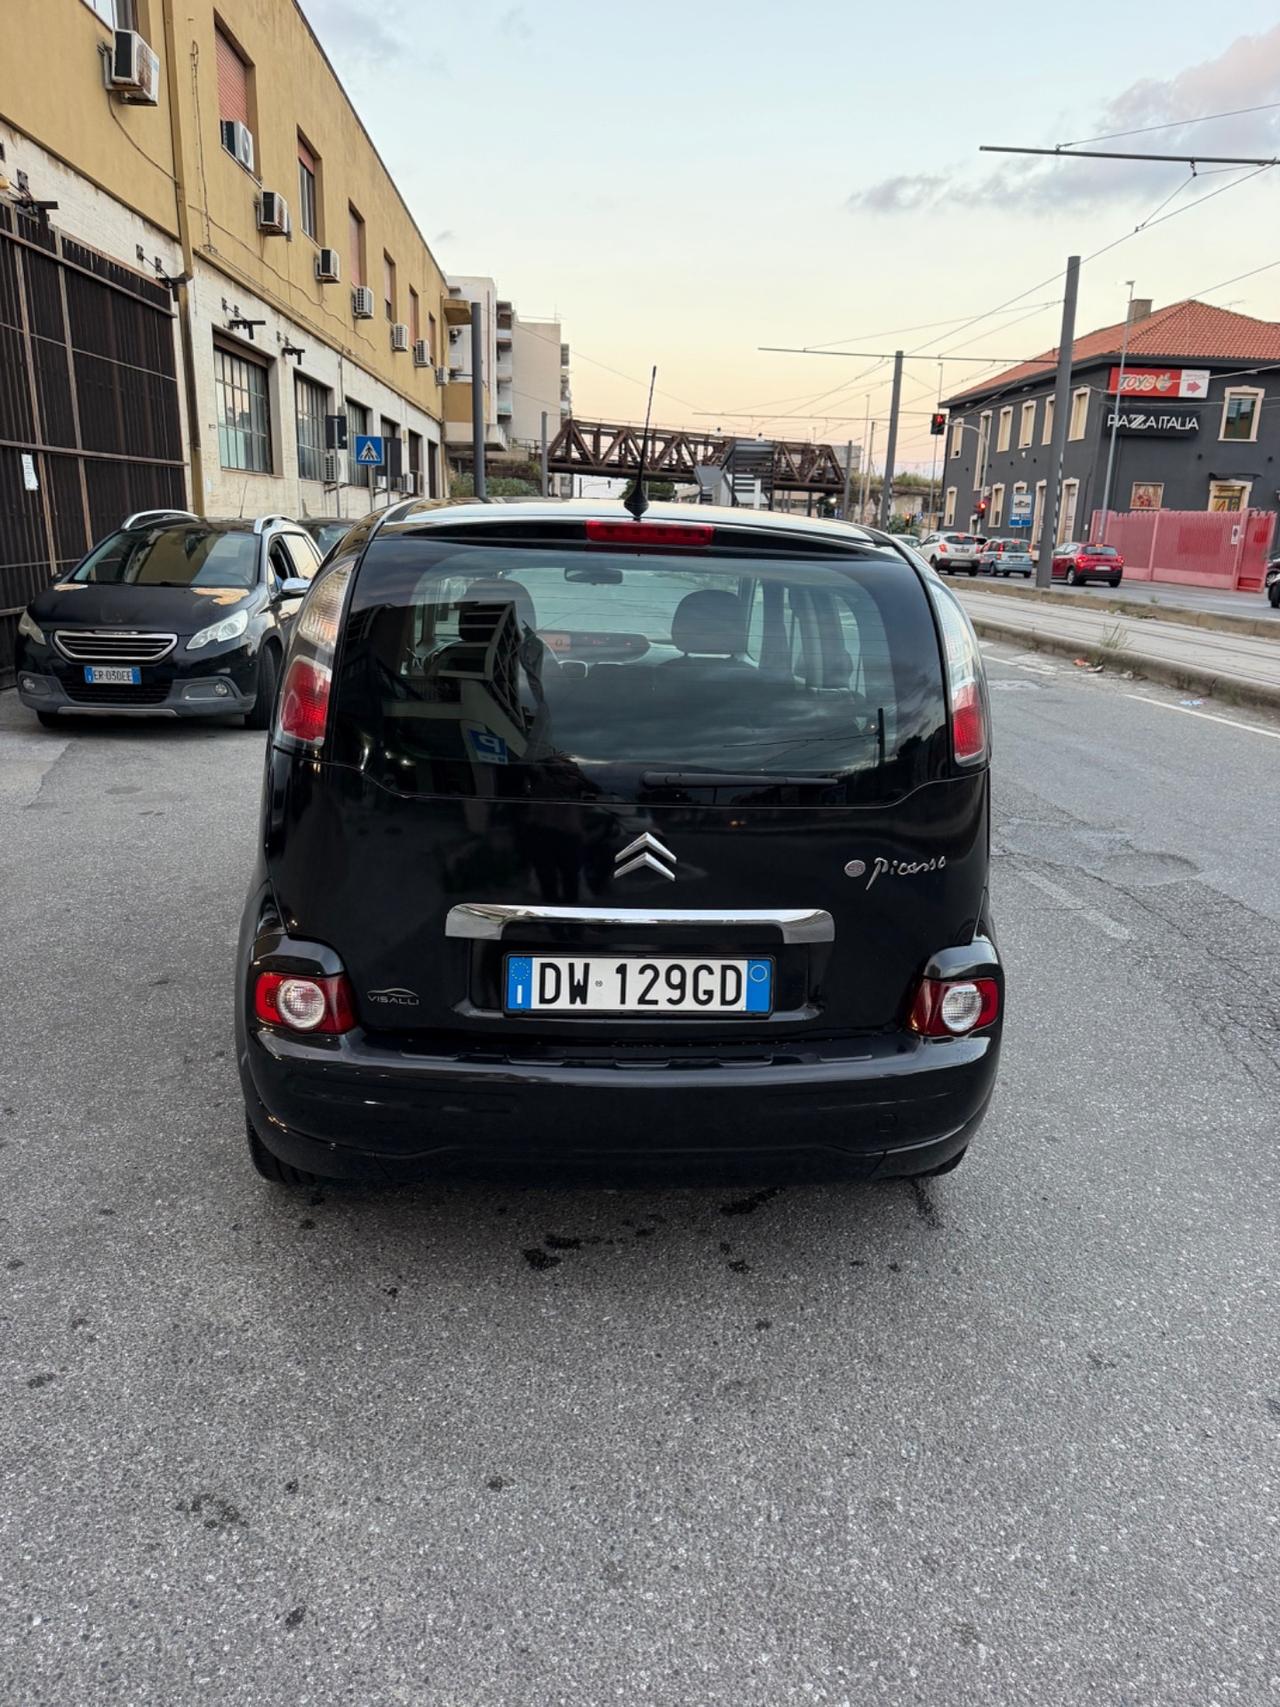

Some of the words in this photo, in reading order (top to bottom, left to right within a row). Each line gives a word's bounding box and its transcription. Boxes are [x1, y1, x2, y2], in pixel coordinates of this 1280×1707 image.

[1158, 416, 1199, 430] ITALIA
[538, 962, 590, 1006] DW
[615, 963, 743, 1007] 129GD
